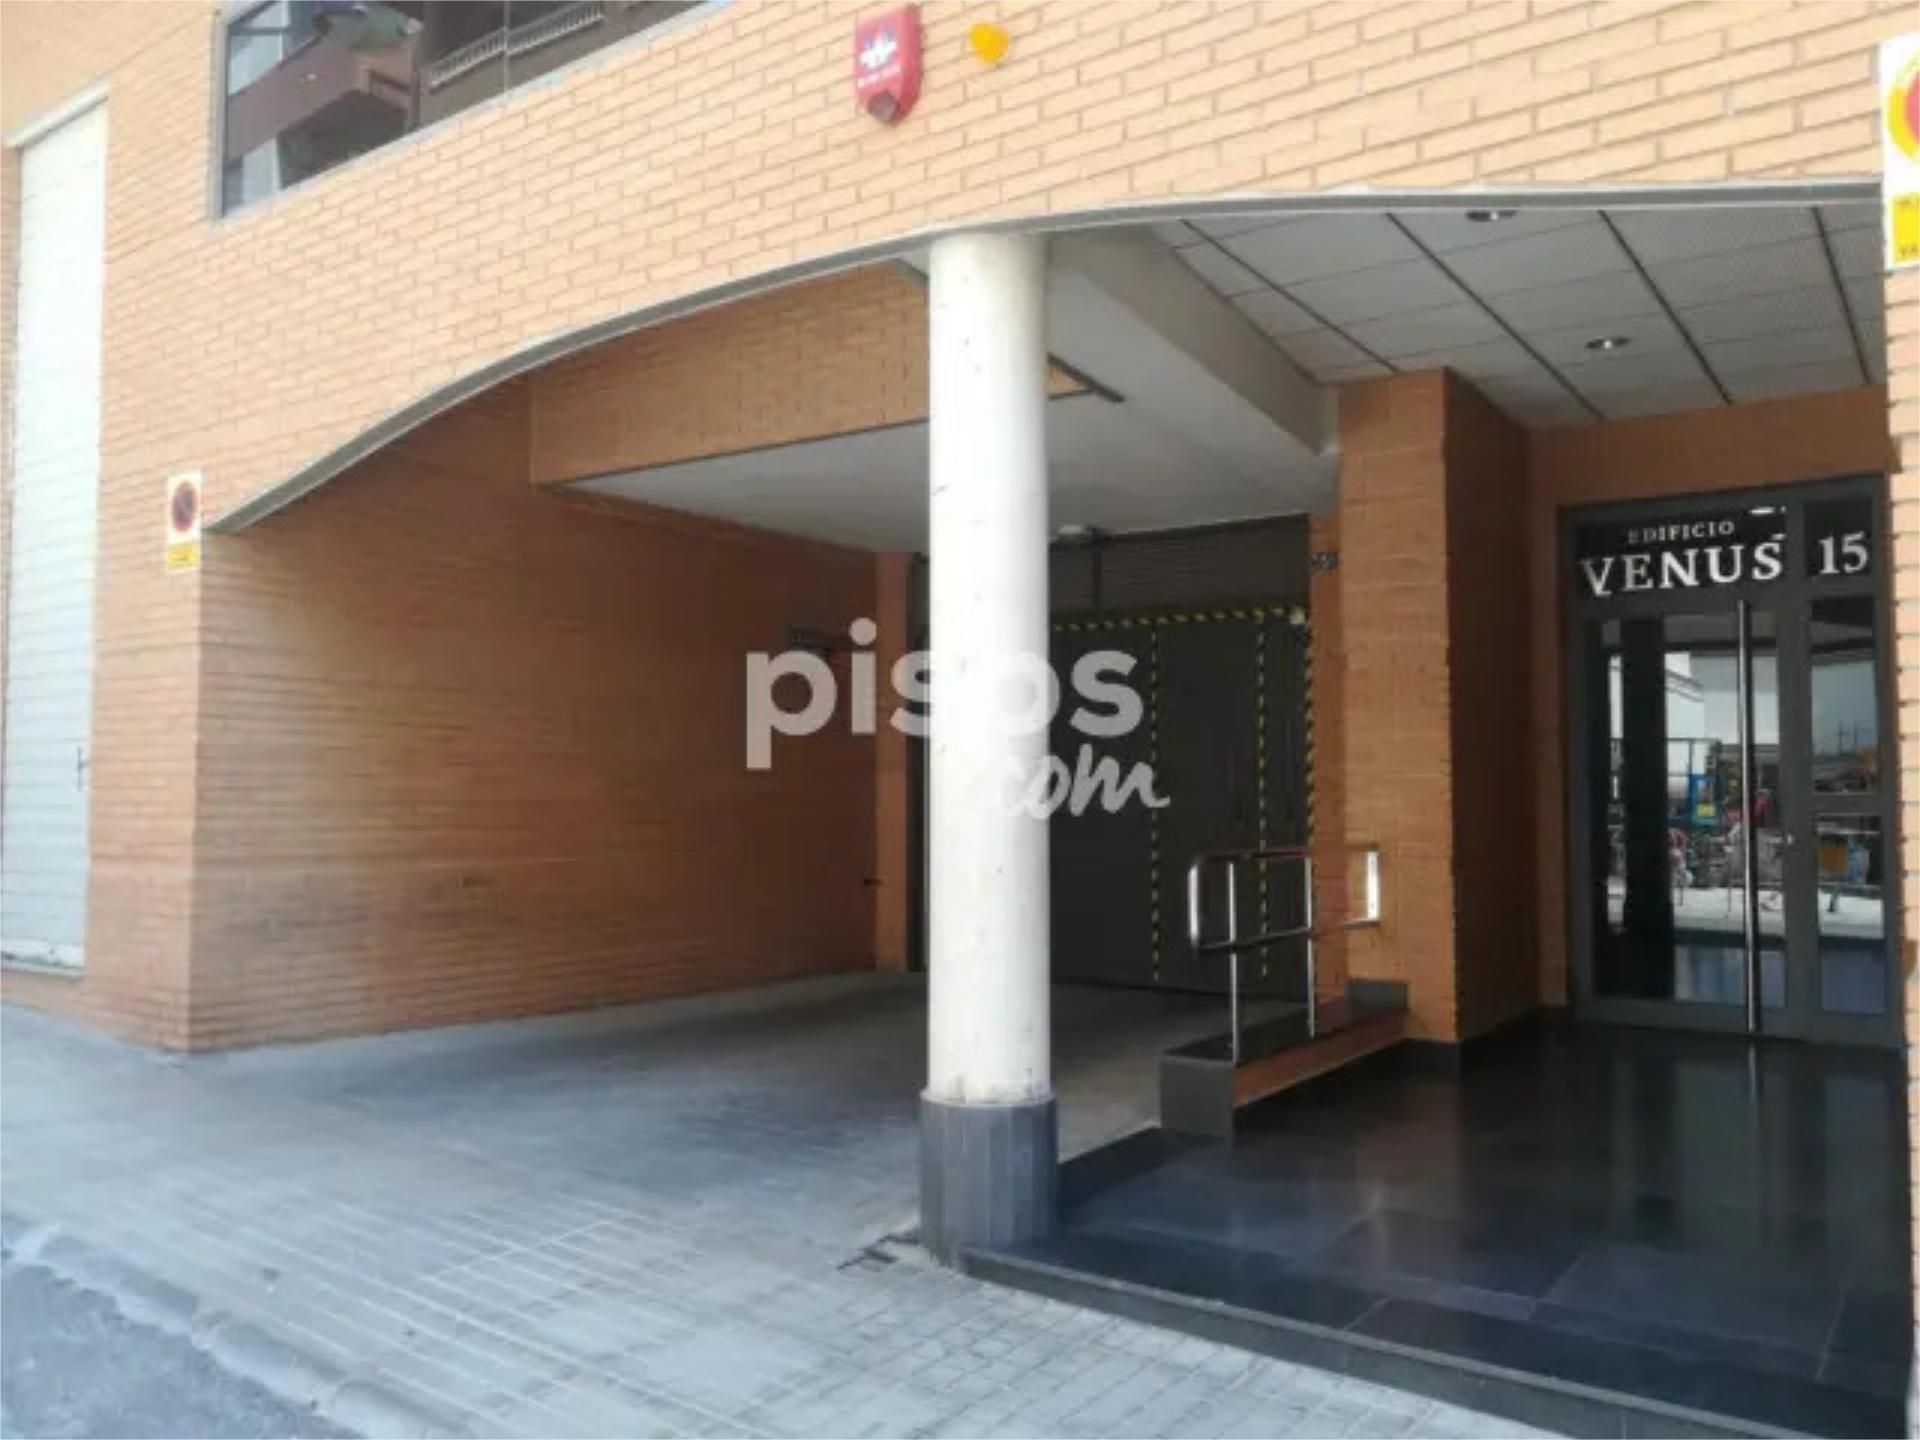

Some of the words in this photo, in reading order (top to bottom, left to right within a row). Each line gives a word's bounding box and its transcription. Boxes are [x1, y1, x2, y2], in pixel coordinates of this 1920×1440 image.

[1627, 520, 1736, 545] EDIFICIO
[1817, 530, 1869, 575] 15
[1579, 541, 1784, 598] VENUS
